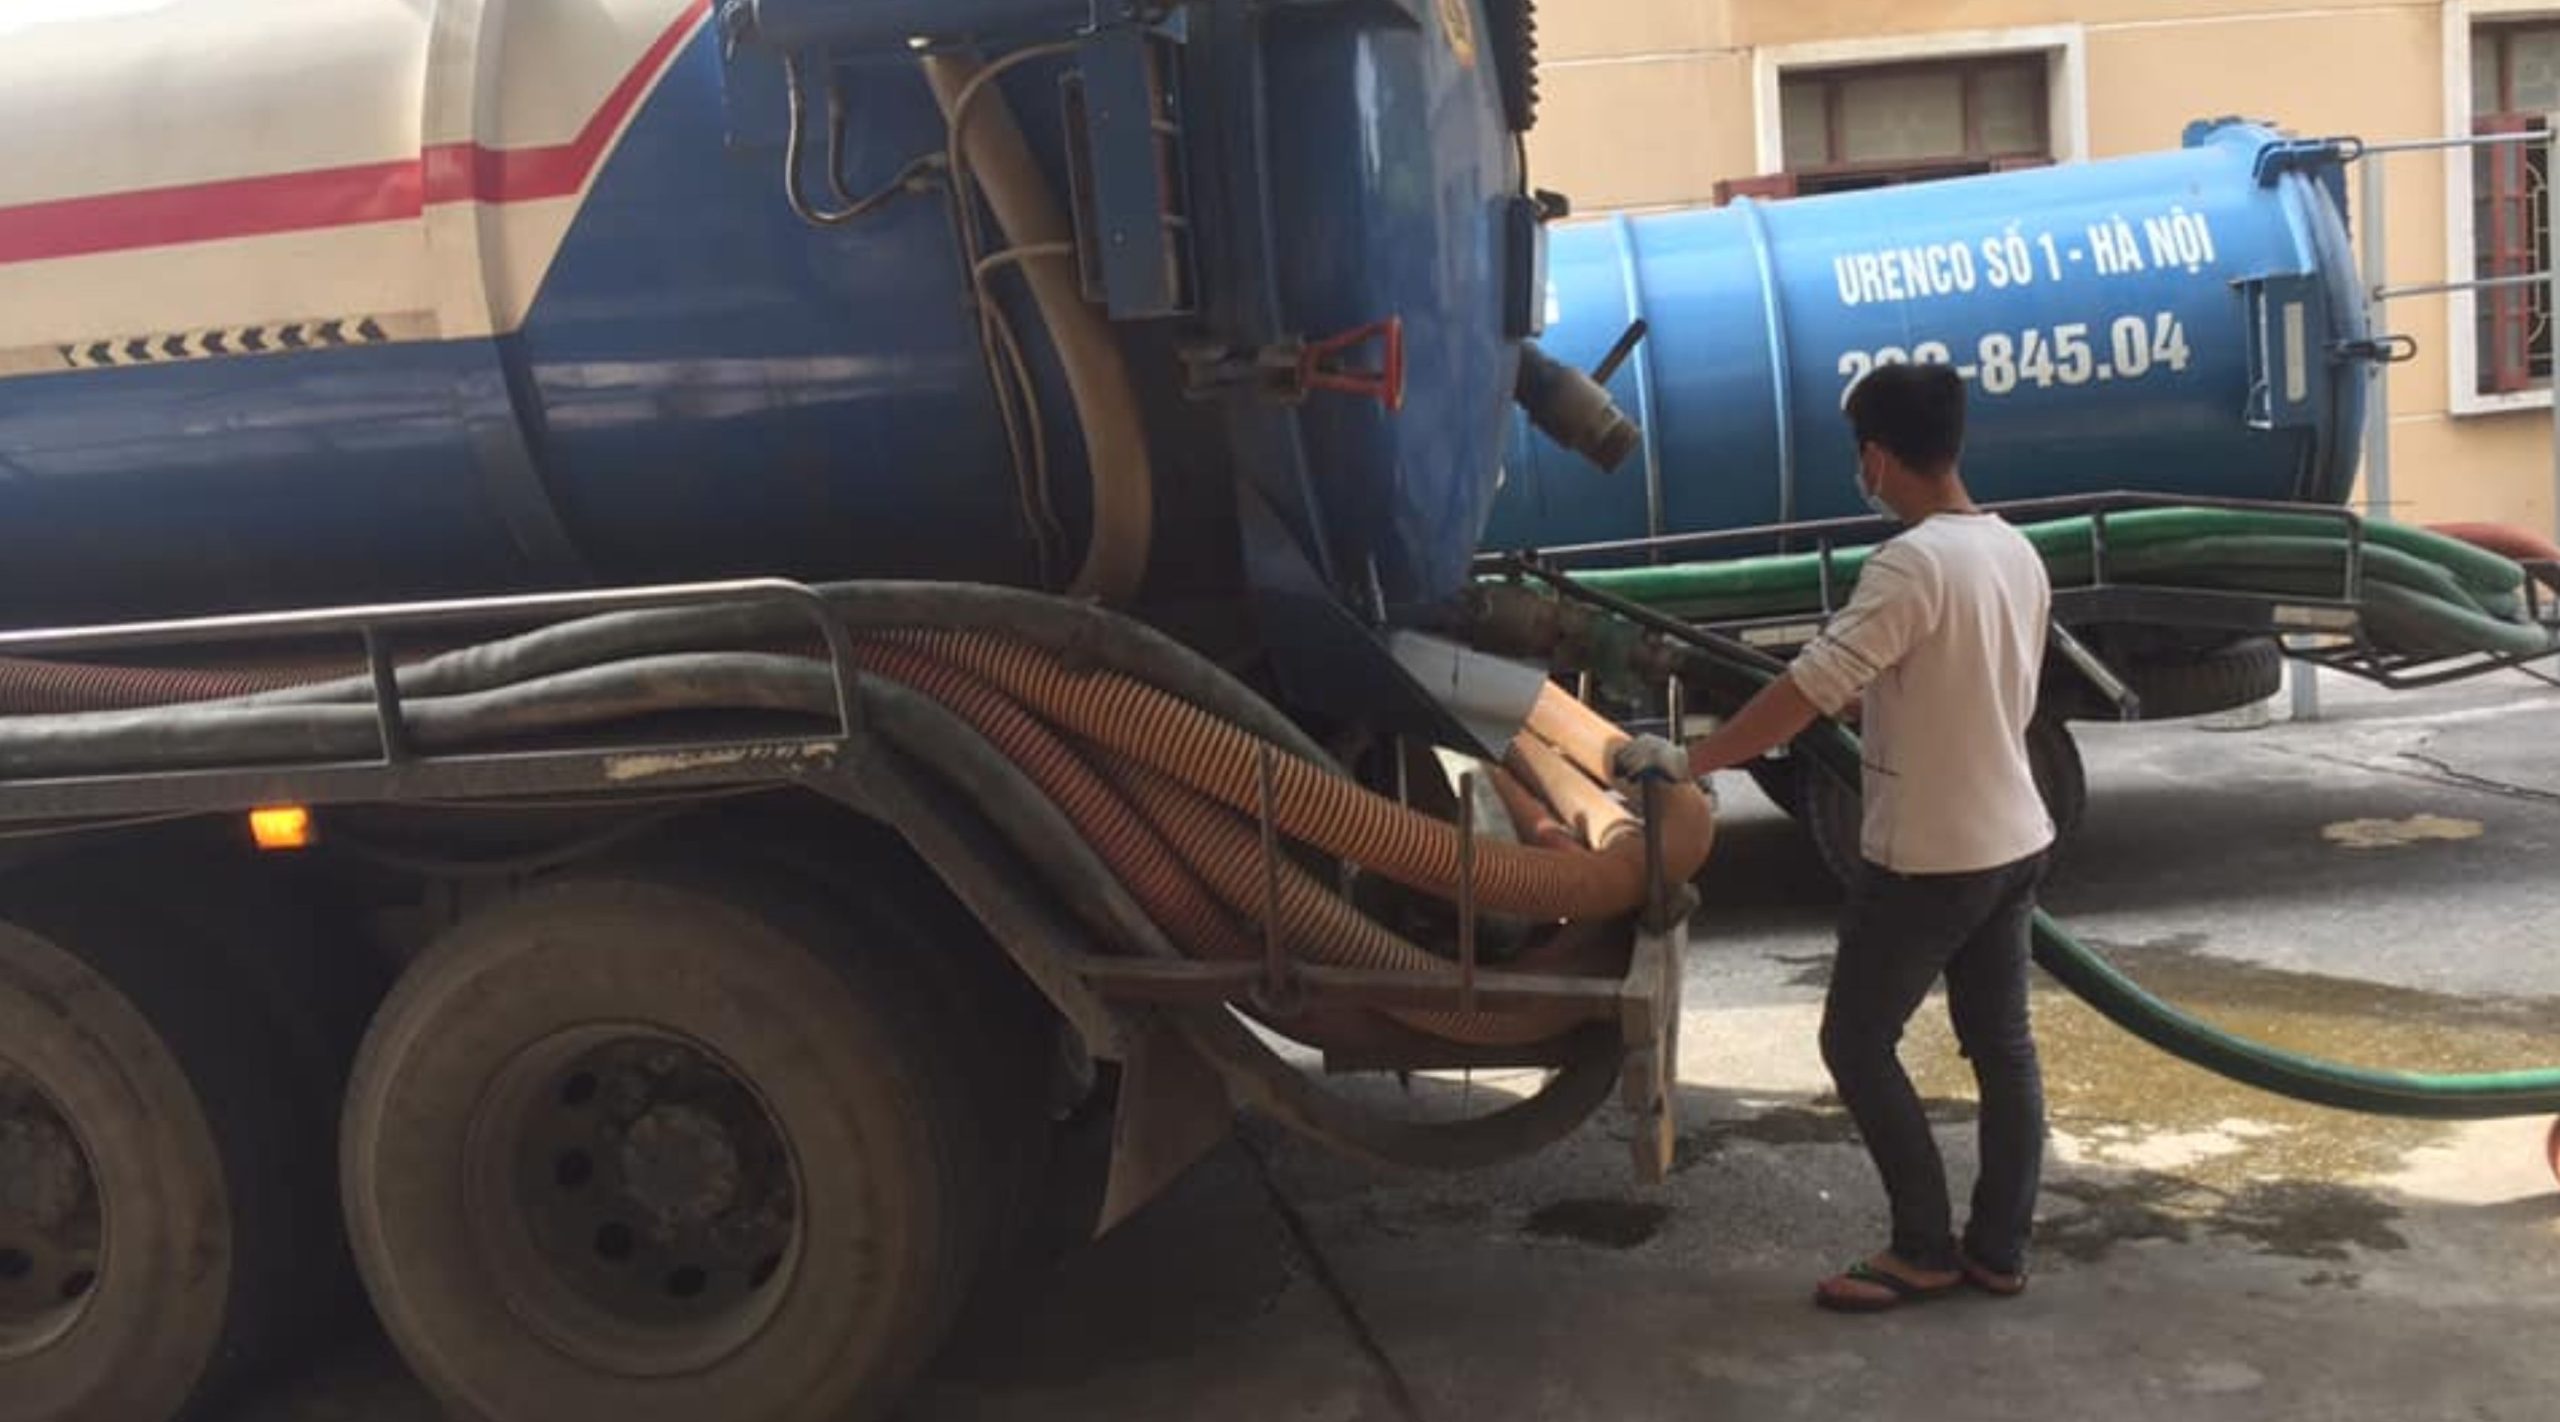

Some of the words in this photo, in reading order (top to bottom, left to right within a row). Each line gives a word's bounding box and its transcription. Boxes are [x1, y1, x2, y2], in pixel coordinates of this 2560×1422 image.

[1832, 239, 1977, 306] URENCO
[1981, 218, 2033, 288] SỐ
[2038, 231, 2062, 282] 1
[2069, 248, 2083, 262] -
[2087, 212, 2145, 275] HÀ
[2143, 204, 2216, 275] NỘI
